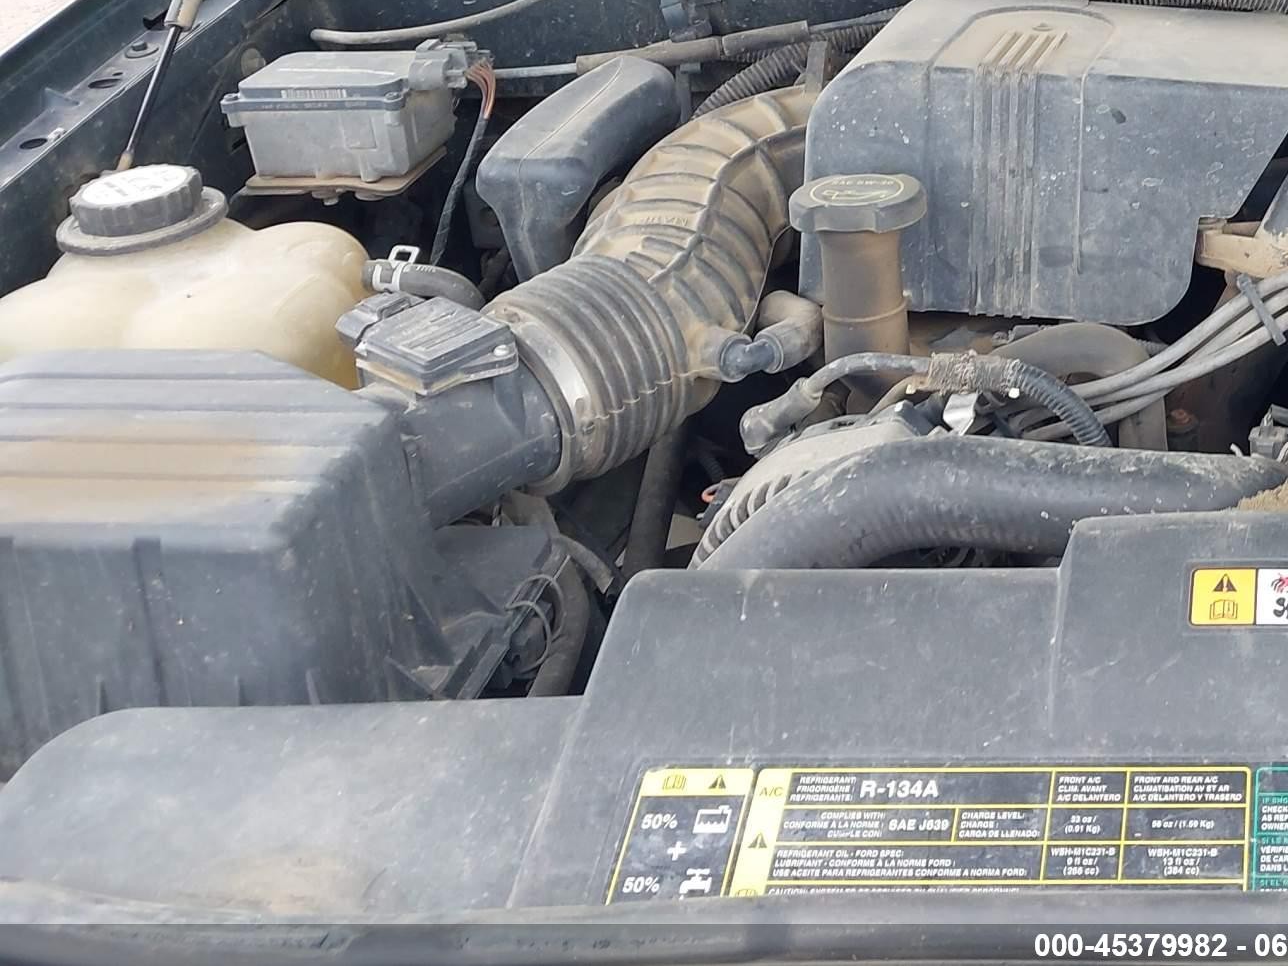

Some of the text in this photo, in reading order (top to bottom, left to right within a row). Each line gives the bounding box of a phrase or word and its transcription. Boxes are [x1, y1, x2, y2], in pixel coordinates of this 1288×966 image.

[1059, 776, 1101, 784] FRONT A/C
[1134, 776, 1218, 784] FRONT AND REAR A/C
[759, 786, 783, 797] A/C
[859, 780, 939, 798] R-134A
[1081, 785, 1107, 793] AVANT
[1133, 785, 1193, 793] CLIMATISATION
[1219, 785, 1230, 793] AR
[1057, 793, 1121, 801] A/C DELANTERO
[1133, 793, 1147, 801] A/C
[1148, 793, 1196, 801] DELANTERO
[1204, 793, 1242, 801] TRASERO
[1262, 805, 1288, 813] CHECK
[821, 811, 861, 819] COMPLIES
[641, 814, 678, 829] 50%
[783, 820, 829, 828] CONFORME
[838, 820, 849, 828] LA
[850, 820, 880, 828] NORME
[959, 830, 985, 838] CARGA
[986, 830, 997, 838] DE
[776, 849, 834, 858] REFRIGERANT
[835, 849, 848, 858] OIL
[855, 849, 878, 858] FORD
[1260, 854, 1271, 862] DE
[774, 859, 822, 867] LUBRIFIANT
[828, 859, 875, 867] CONFORME
[884, 859, 895, 867] LA
[896, 859, 927, 867] NORME
[928, 859, 951, 867] FORD
[1260, 863, 1281, 871] DANS
[772, 868, 790, 877] USE
[790, 868, 820, 877] ACEITE
[821, 868, 844, 877] PARA
[845, 868, 913, 877] REFRIGERANTES
[914, 868, 961, 877] CONFORME
[970, 868, 1000, 877] NORMA
[622, 877, 659, 893] 50%
